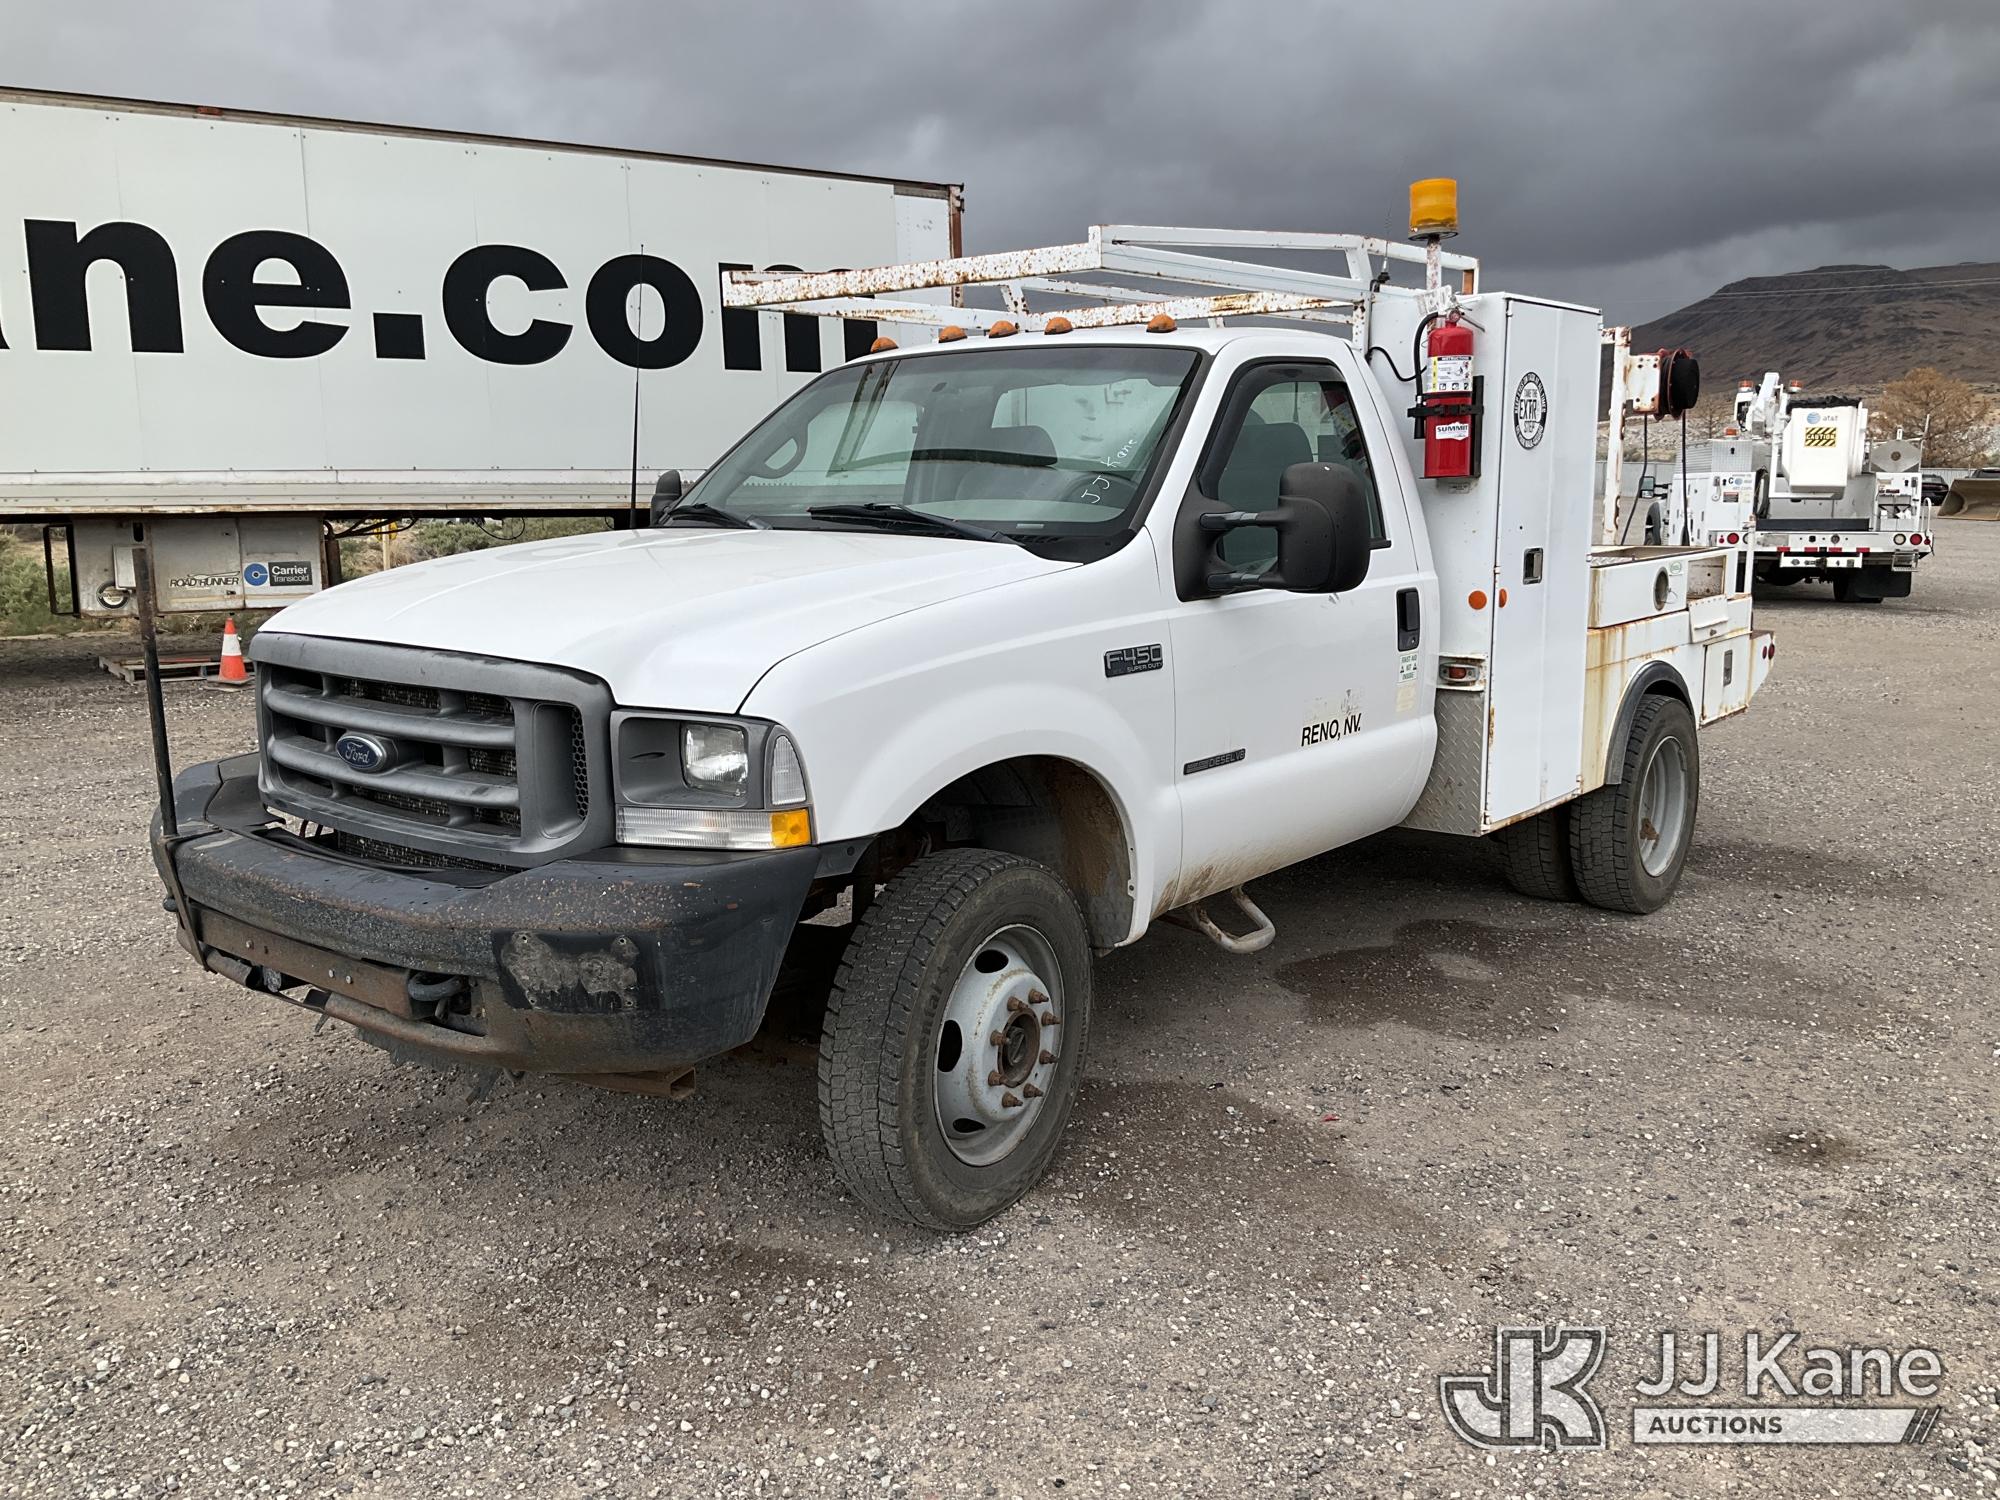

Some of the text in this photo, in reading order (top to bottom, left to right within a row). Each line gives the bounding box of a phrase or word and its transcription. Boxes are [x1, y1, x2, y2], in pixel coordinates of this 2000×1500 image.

[0, 218, 878, 373] ne.com
[271, 565, 308, 575] Carrier
[169, 576, 240, 588] ROAD RUNNER
[272, 574, 310, 583] Transicold
[1127, 661, 1162, 673] SUPER DUTY
[1301, 712, 1362, 747] RENO, NV.
[344, 741, 370, 764] Ford
